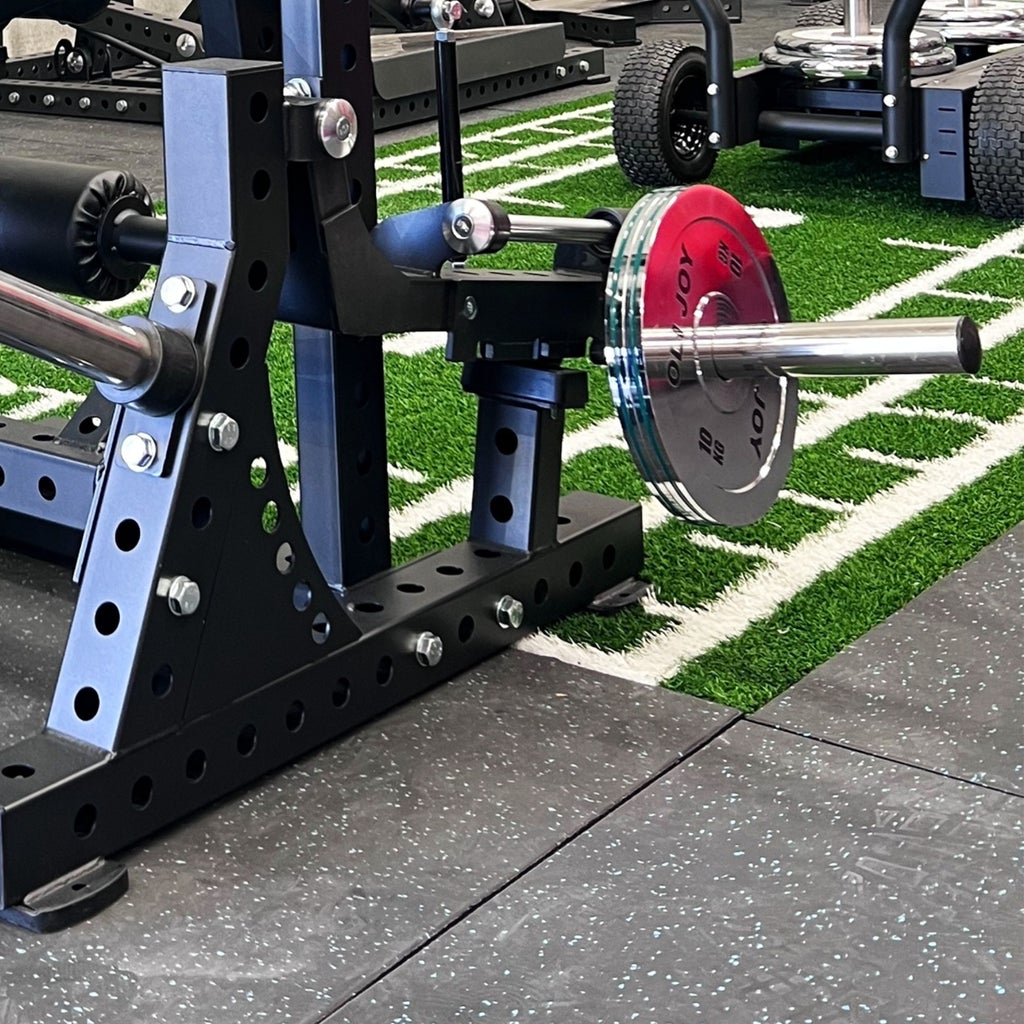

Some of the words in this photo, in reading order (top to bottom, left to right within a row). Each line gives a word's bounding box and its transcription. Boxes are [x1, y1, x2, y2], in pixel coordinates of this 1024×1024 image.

[676, 243, 693, 317] JOY
[698, 426, 714, 455] 10
[749, 383, 766, 460] JOY
[712, 439, 726, 466] KG
